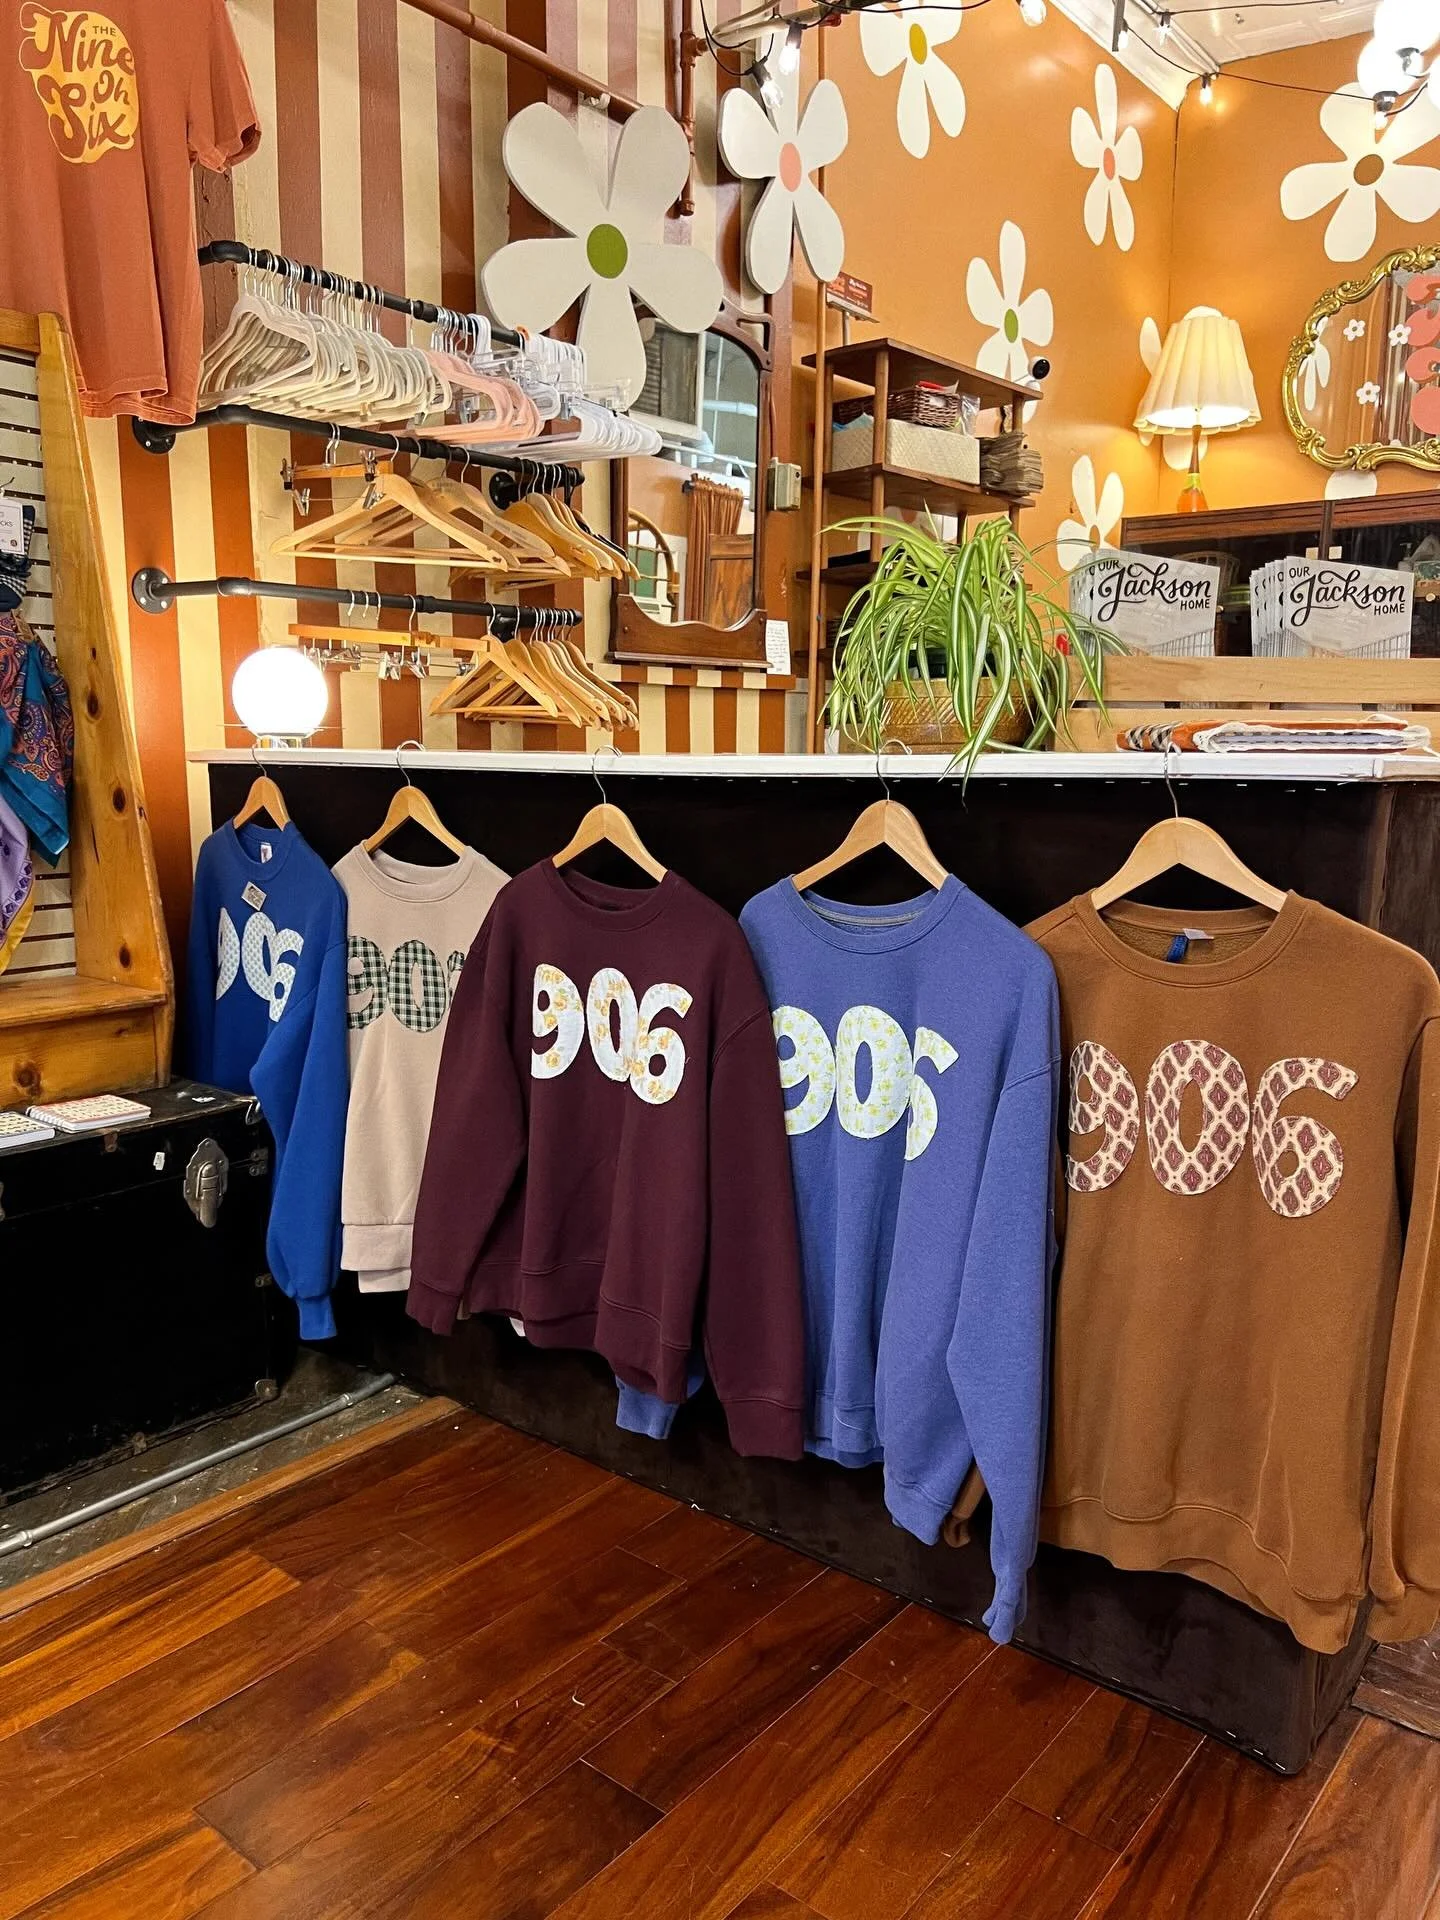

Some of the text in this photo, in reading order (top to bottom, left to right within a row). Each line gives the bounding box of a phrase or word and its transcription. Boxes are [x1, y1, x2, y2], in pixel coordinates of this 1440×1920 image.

[20, 2, 134, 75] Nine
[92, 25, 116, 36] THE
[37, 74, 131, 158] Six
[93, 70, 130, 105] Oh
[1097, 562, 1211, 622] Jackson
[1098, 560, 1121, 571] OUR
[1288, 566, 1310, 578] OUR
[1180, 598, 1210, 611] HOME
[1290, 569, 1406, 626] Jackson
[1373, 603, 1405, 616] HOME
[347, 935, 465, 1033] 90
[531, 963, 693, 1105] 906
[1065, 1039, 1359, 1217] 906
